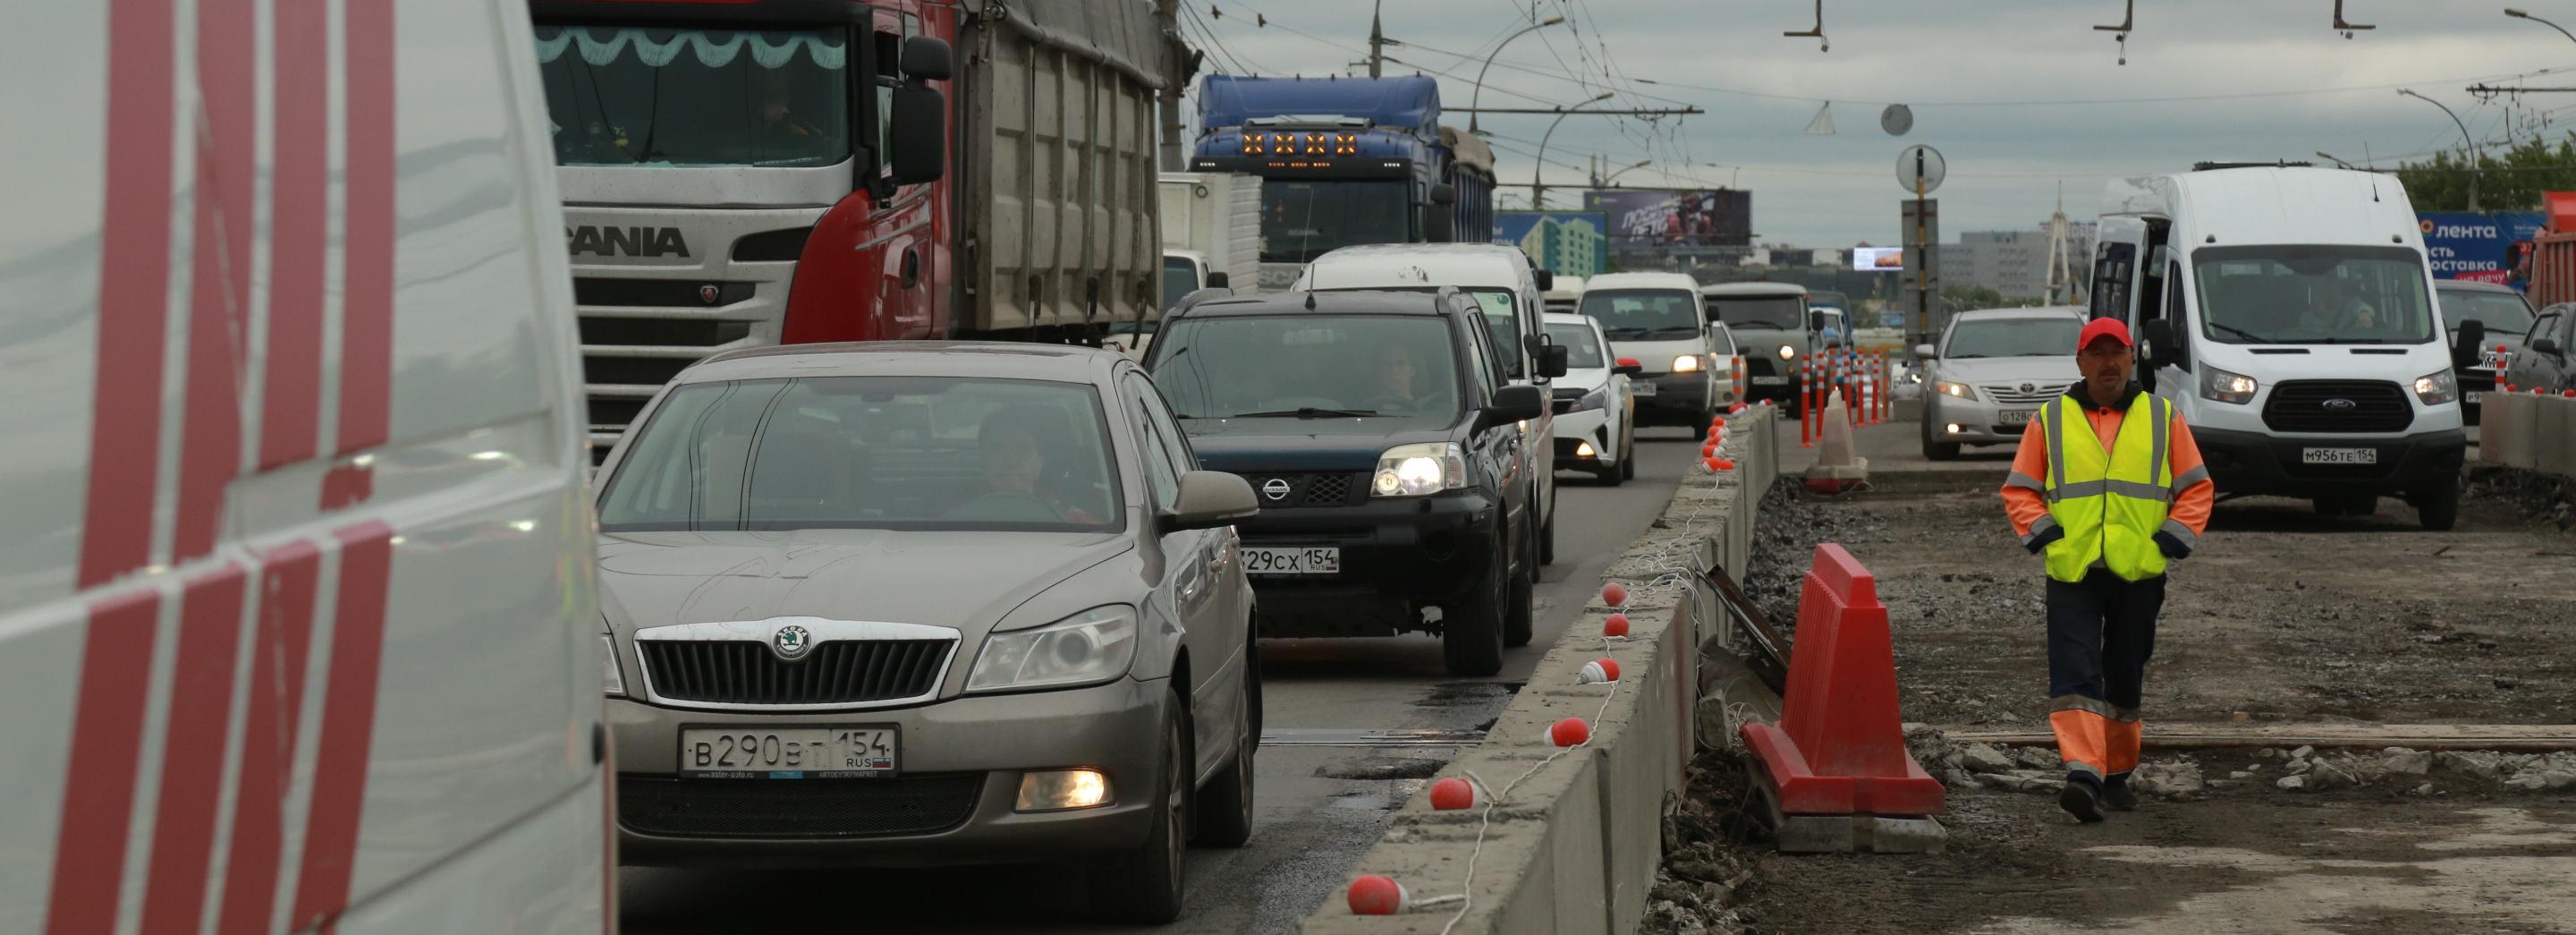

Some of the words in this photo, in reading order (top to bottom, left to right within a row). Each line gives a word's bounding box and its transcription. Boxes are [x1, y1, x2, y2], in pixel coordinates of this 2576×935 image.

[2436, 225, 2497, 239] лента
[566, 225, 691, 257] ANIA
[2427, 247, 2455, 258] сть
[2430, 260, 2497, 271] оставка
[2356, 450, 2375, 461] 154
[835, 731, 886, 757] 154
[846, 758, 872, 768] RUS
